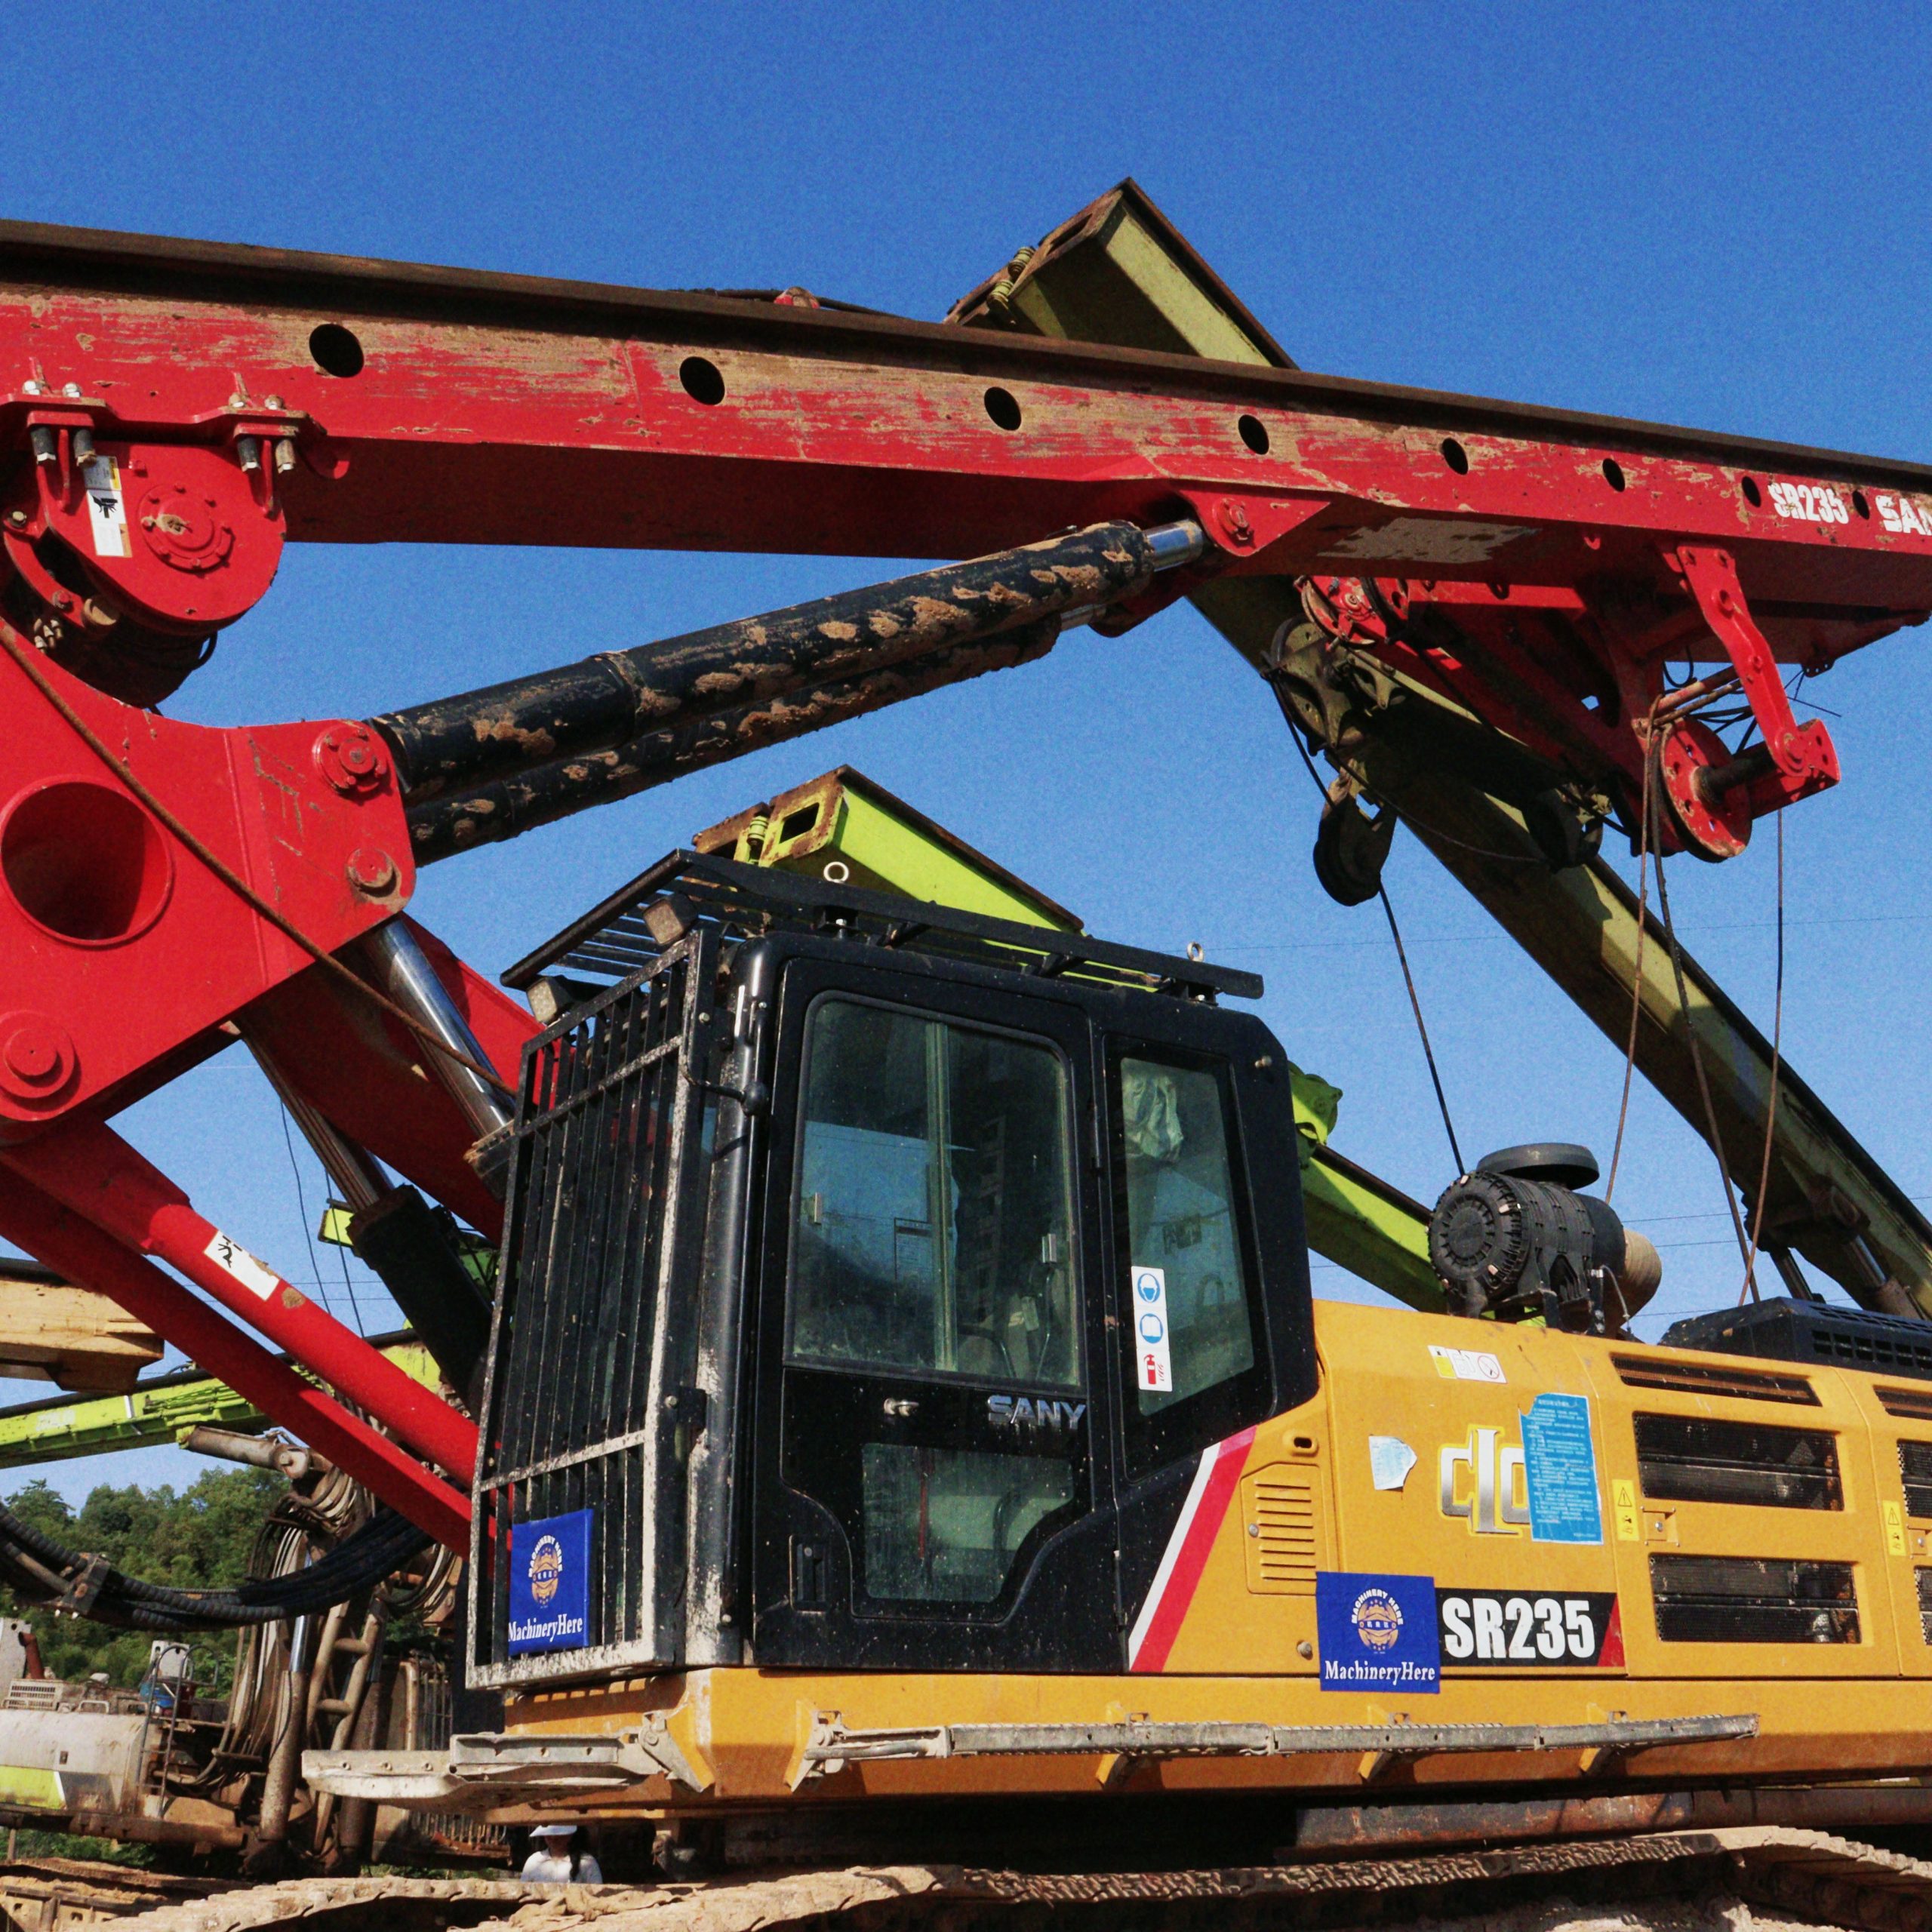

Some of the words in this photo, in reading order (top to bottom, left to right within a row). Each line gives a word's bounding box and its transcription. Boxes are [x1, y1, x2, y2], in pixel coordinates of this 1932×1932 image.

[1767, 482, 1849, 525] SR235
[987, 1395, 1087, 1430] SANY
[508, 1614, 583, 1642] MachineryHere
[1441, 1597, 1596, 1659] SR235
[1324, 1660, 1435, 1686] MachineryHere
